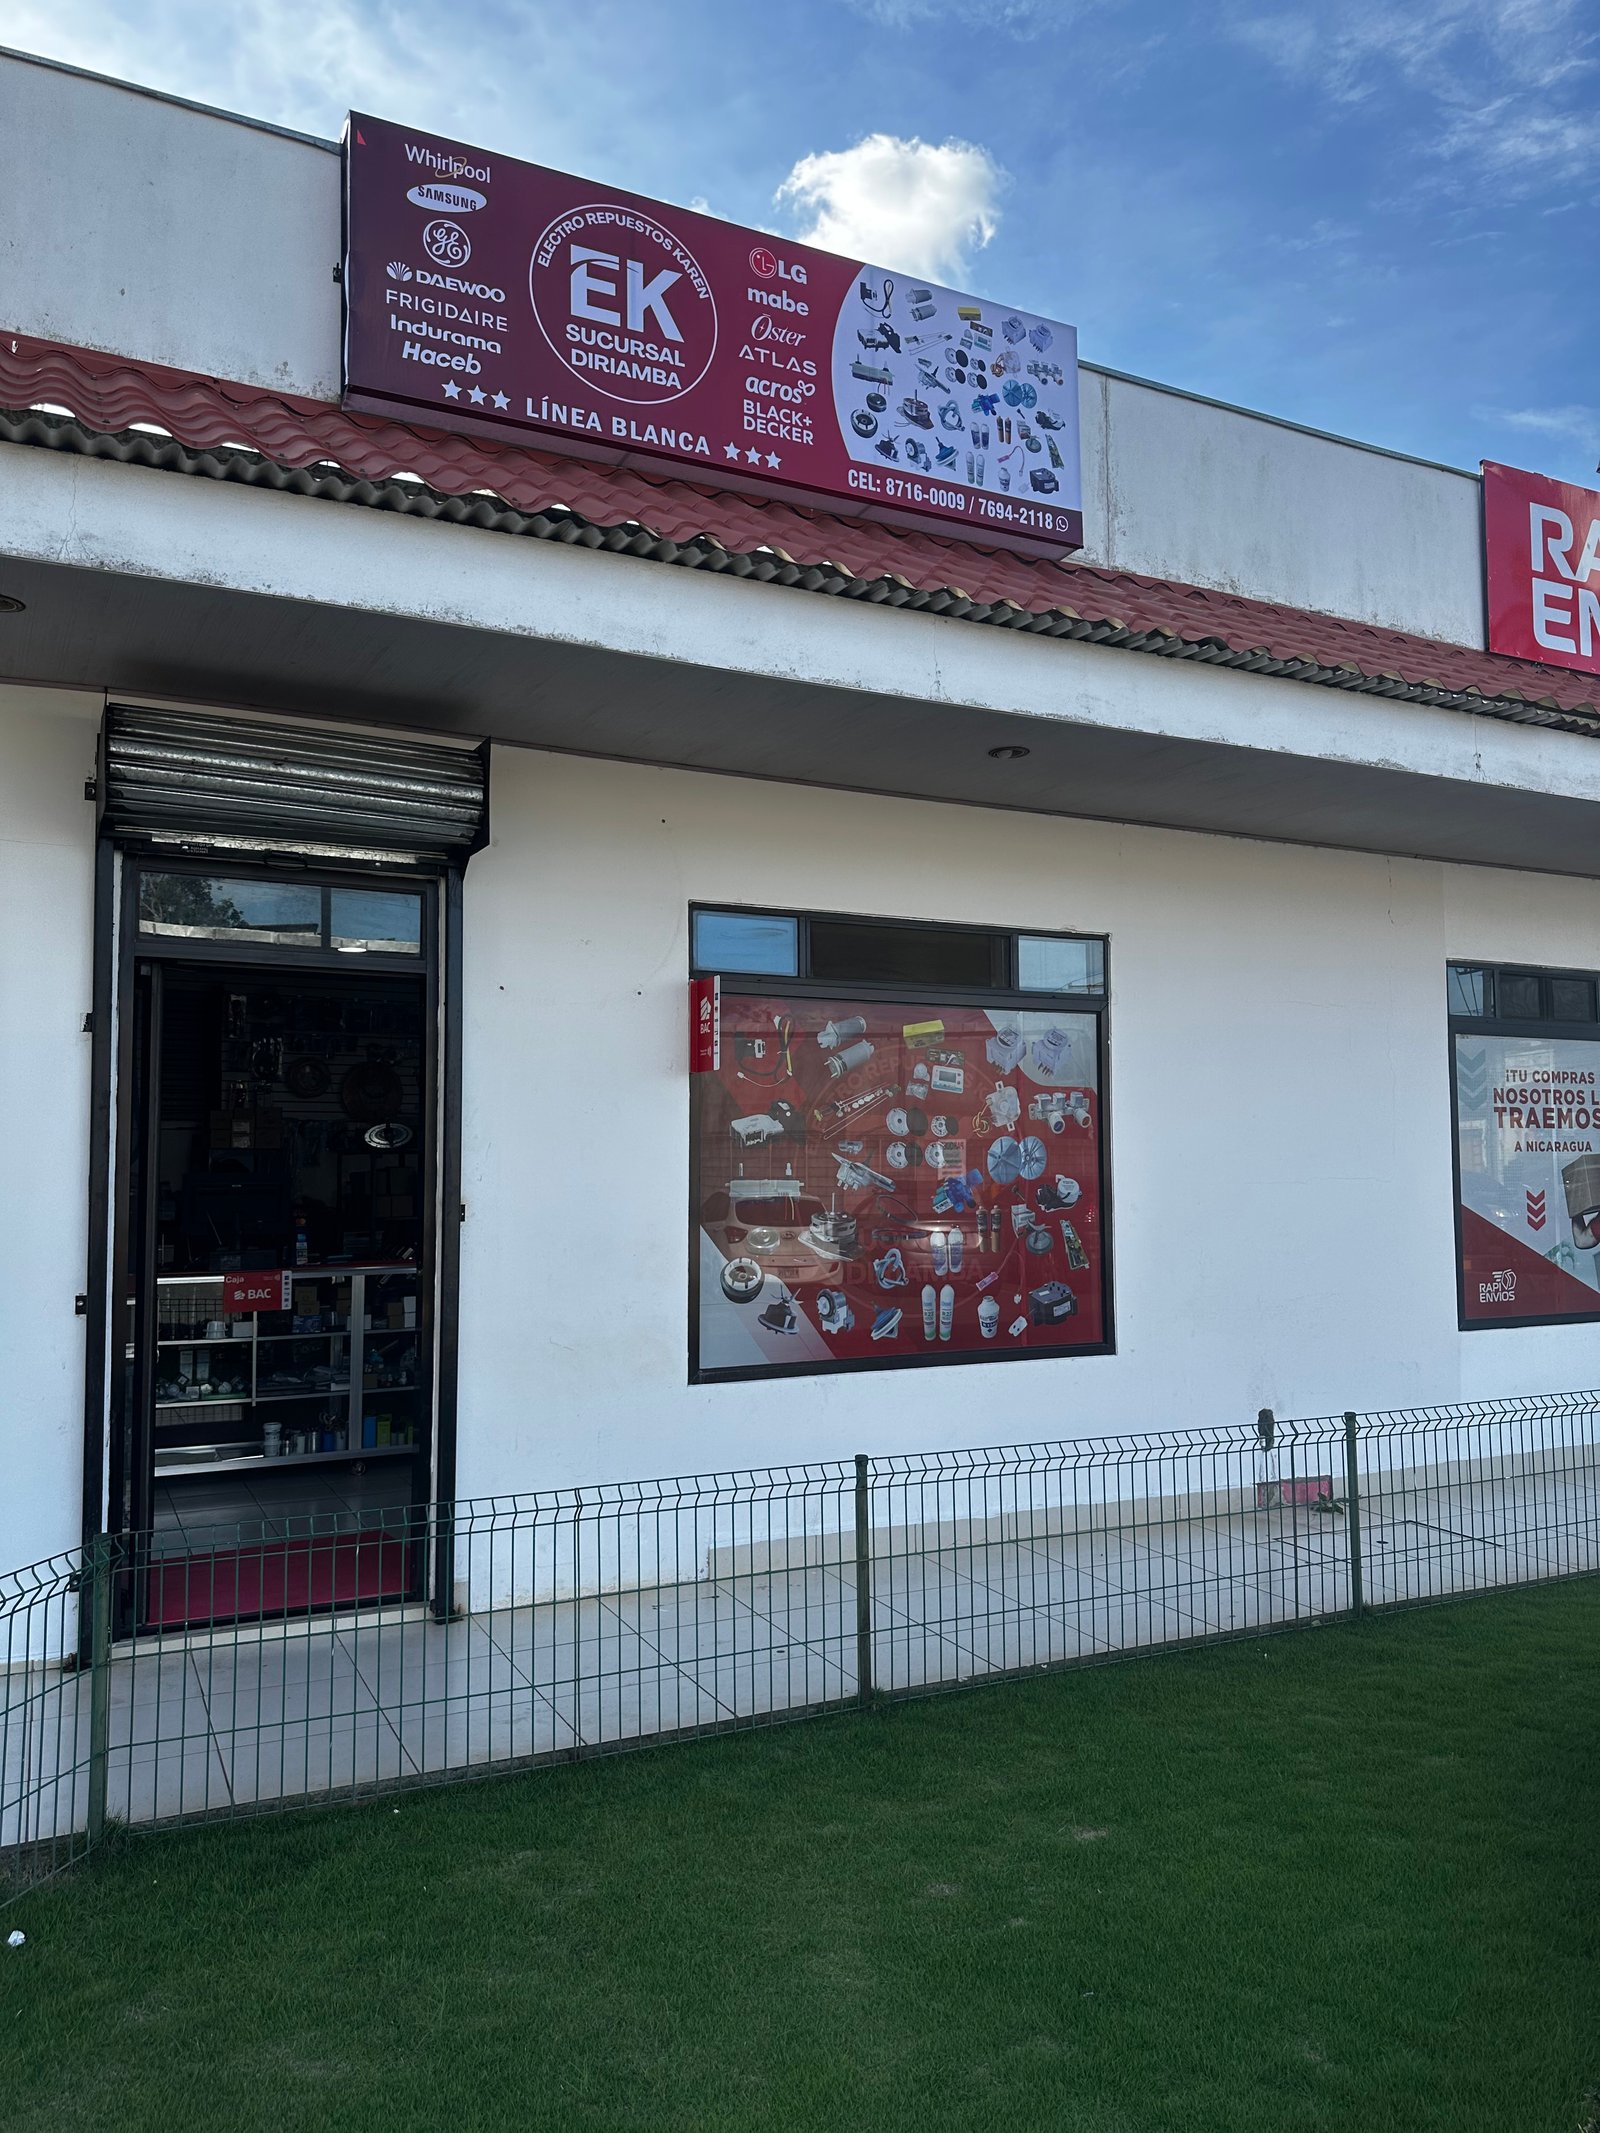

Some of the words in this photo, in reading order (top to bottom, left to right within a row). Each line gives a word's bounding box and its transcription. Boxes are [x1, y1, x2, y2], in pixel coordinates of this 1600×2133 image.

[405, 144, 490, 183] Whirlpool
[417, 185, 476, 211] SAMSUNG
[538, 216, 584, 267] ELECTRO
[585, 212, 673, 251] REPUESTOS
[672, 248, 710, 299] KAREN
[416, 270, 506, 302] DAEWOO
[778, 260, 807, 284] LG
[571, 244, 685, 343] EK
[747, 287, 809, 316] mabe
[386, 289, 508, 332] FRIGIDAIRE
[390, 314, 502, 354] Indurama
[565, 323, 686, 368] SUCURSAL
[402, 341, 482, 375] Haceb
[571, 348, 682, 390] DIRIAMBA
[739, 344, 817, 376] ATLAS
[745, 376, 803, 404] acros
[526, 395, 603, 433] LÍNEA
[612, 416, 711, 455] BLANCA
[743, 415, 814, 446] DECKER
[848, 469, 881, 492] CEL:
[885, 477, 965, 511] 8716-0009
[968, 495, 975, 514] /
[978, 498, 1054, 530] 7694-2118
[1532, 1070, 1595, 1084] COMPRAS
[1493, 1087, 1586, 1105] NOSOTROS
[1514, 1141, 1523, 1152] A
[1526, 1141, 1593, 1152] NICARAGUA
[225, 1276, 245, 1284] Caja
[247, 1288, 272, 1300] BAC
[1479, 1282, 1502, 1292] RAPI
[1479, 1291, 1516, 1302] ENVIOS
